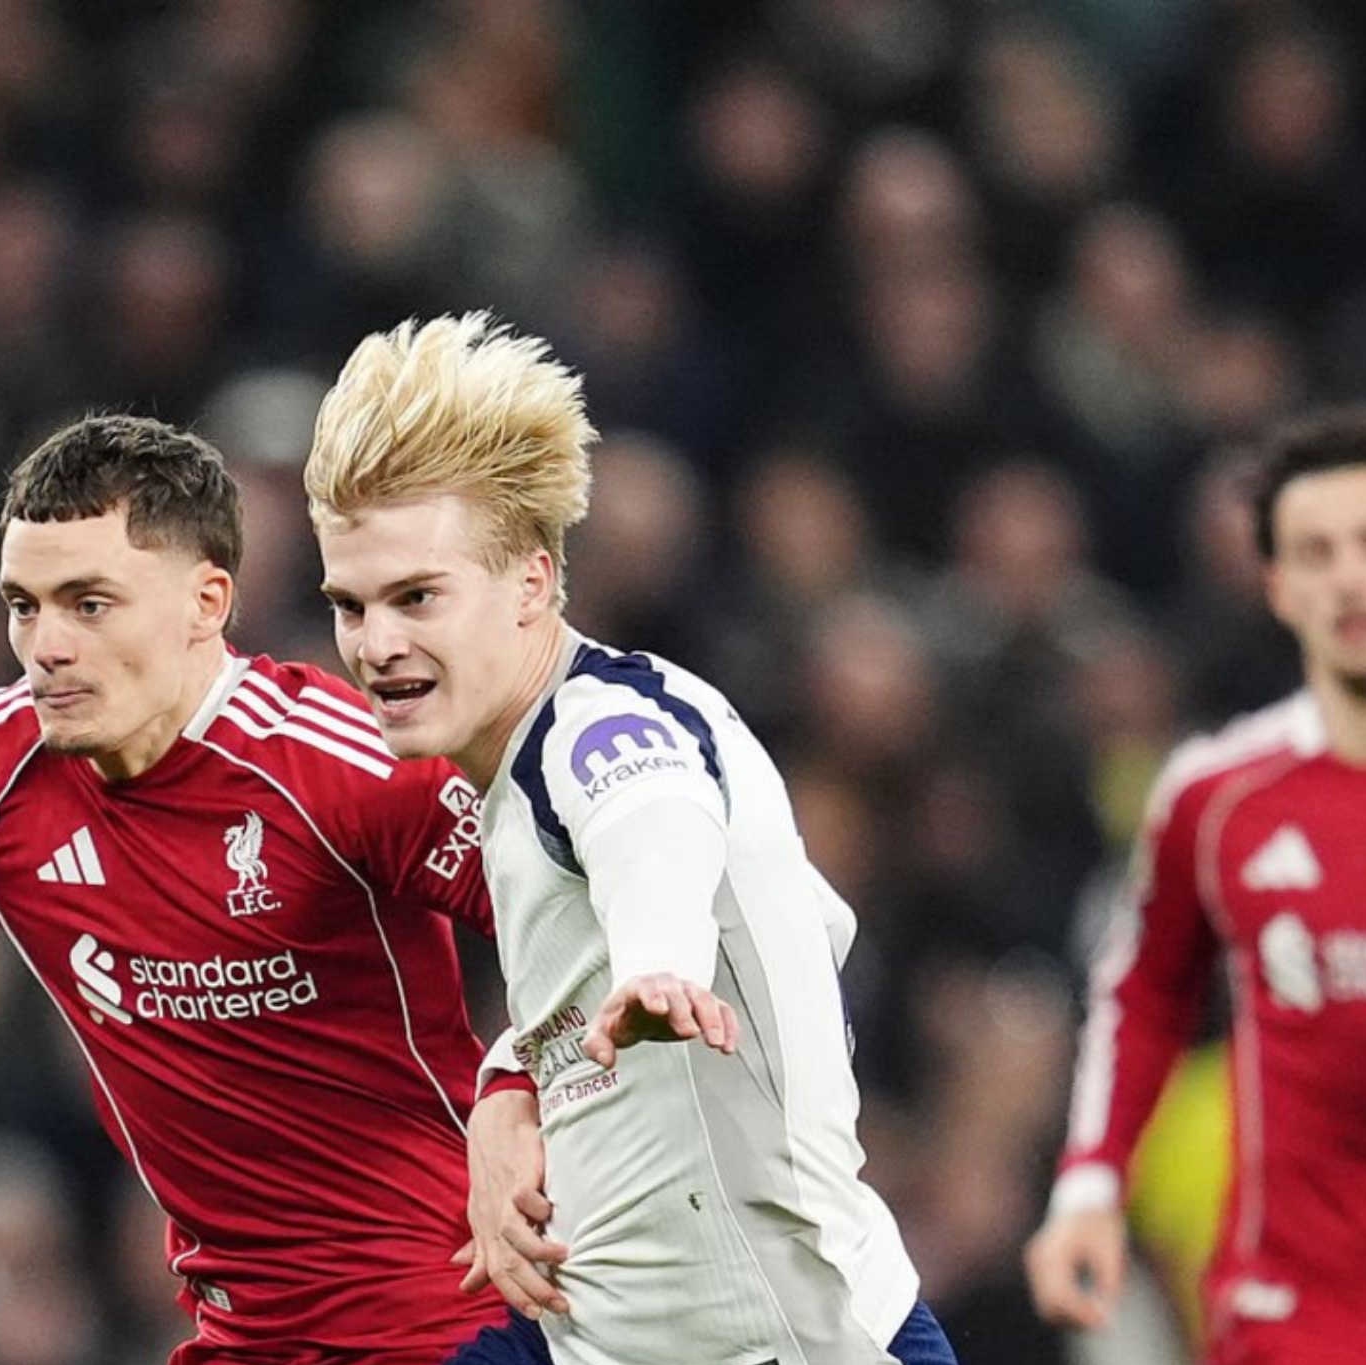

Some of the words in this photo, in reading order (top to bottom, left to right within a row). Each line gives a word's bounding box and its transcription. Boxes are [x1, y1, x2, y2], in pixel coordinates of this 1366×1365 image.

[584, 757, 688, 801] kraken
[130, 949, 296, 987] standard
[137, 972, 318, 1020] chartered
[565, 1071, 618, 1102] Cancer
